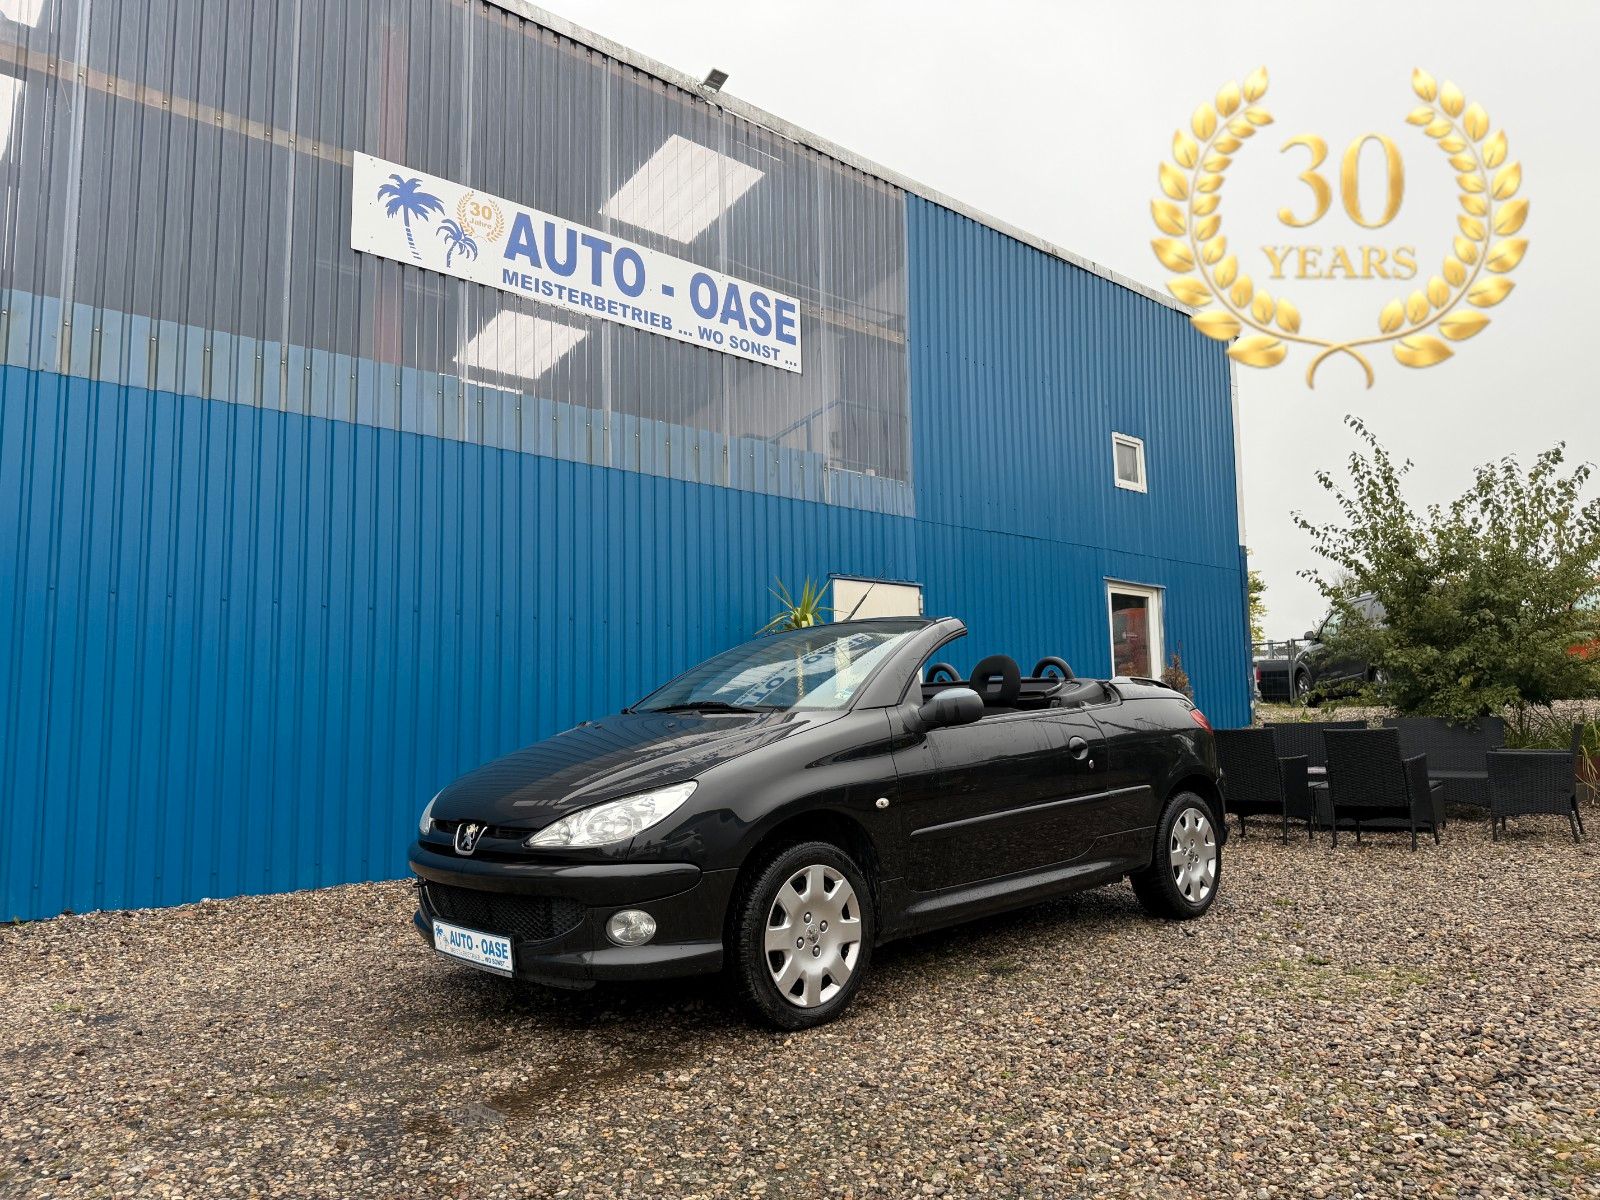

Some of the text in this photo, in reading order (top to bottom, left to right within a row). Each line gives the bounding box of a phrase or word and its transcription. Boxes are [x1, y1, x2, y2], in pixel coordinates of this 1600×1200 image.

[469, 201, 493, 221] 30
[469, 217, 492, 230] Jahre
[503, 211, 646, 298] AUTO
[689, 272, 797, 346] OASE
[502, 268, 673, 331] MEISTERBETRIEB
[698, 325, 724, 345] WO
[728, 335, 781, 362] SONST
[449, 930, 473, 950] AUTO
[481, 938, 509, 960] OASE
